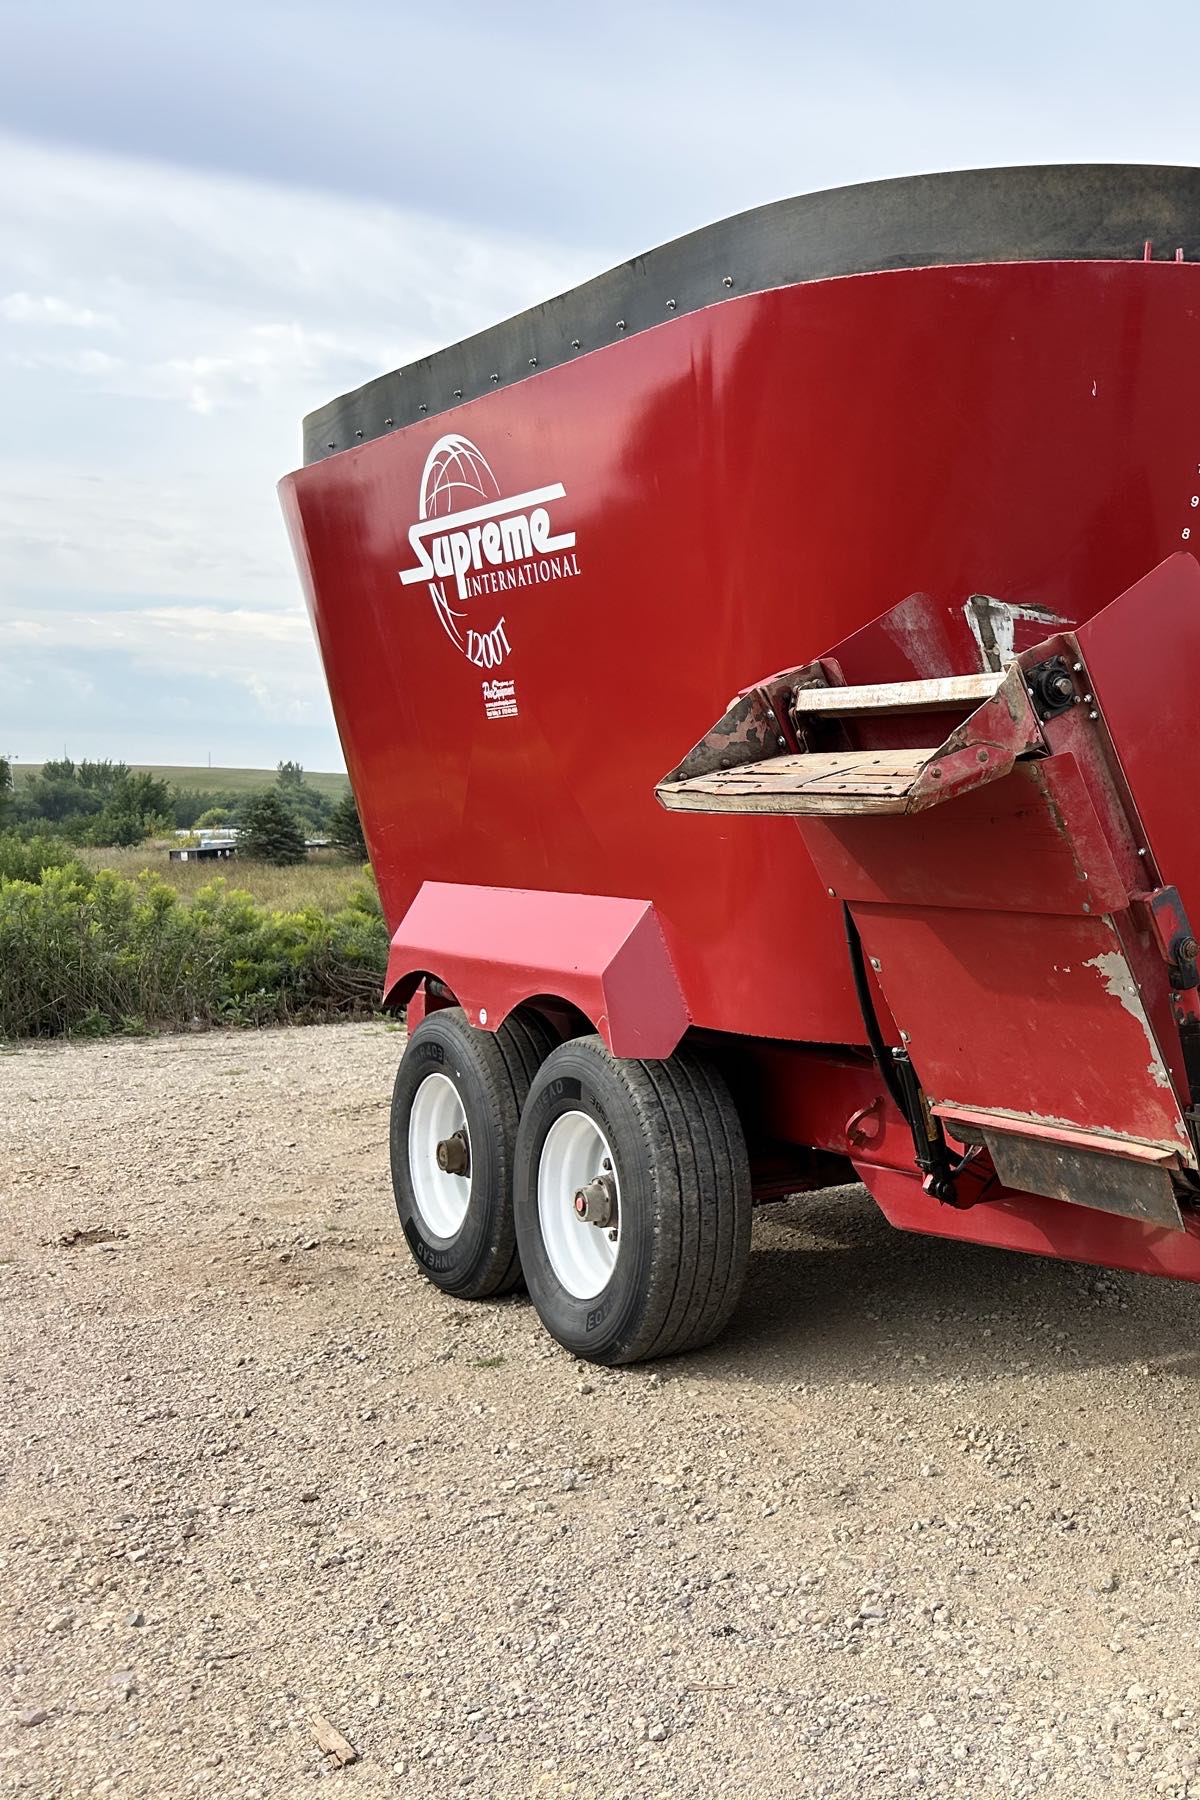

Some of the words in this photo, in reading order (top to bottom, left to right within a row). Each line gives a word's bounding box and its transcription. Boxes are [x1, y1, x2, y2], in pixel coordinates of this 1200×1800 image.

[1190, 495, 1200, 508] 9
[399, 483, 576, 600] Supreme
[1181, 527, 1191, 540] 8
[466, 553, 581, 598] INTERNATIONAL
[465, 617, 512, 669] 1200T
